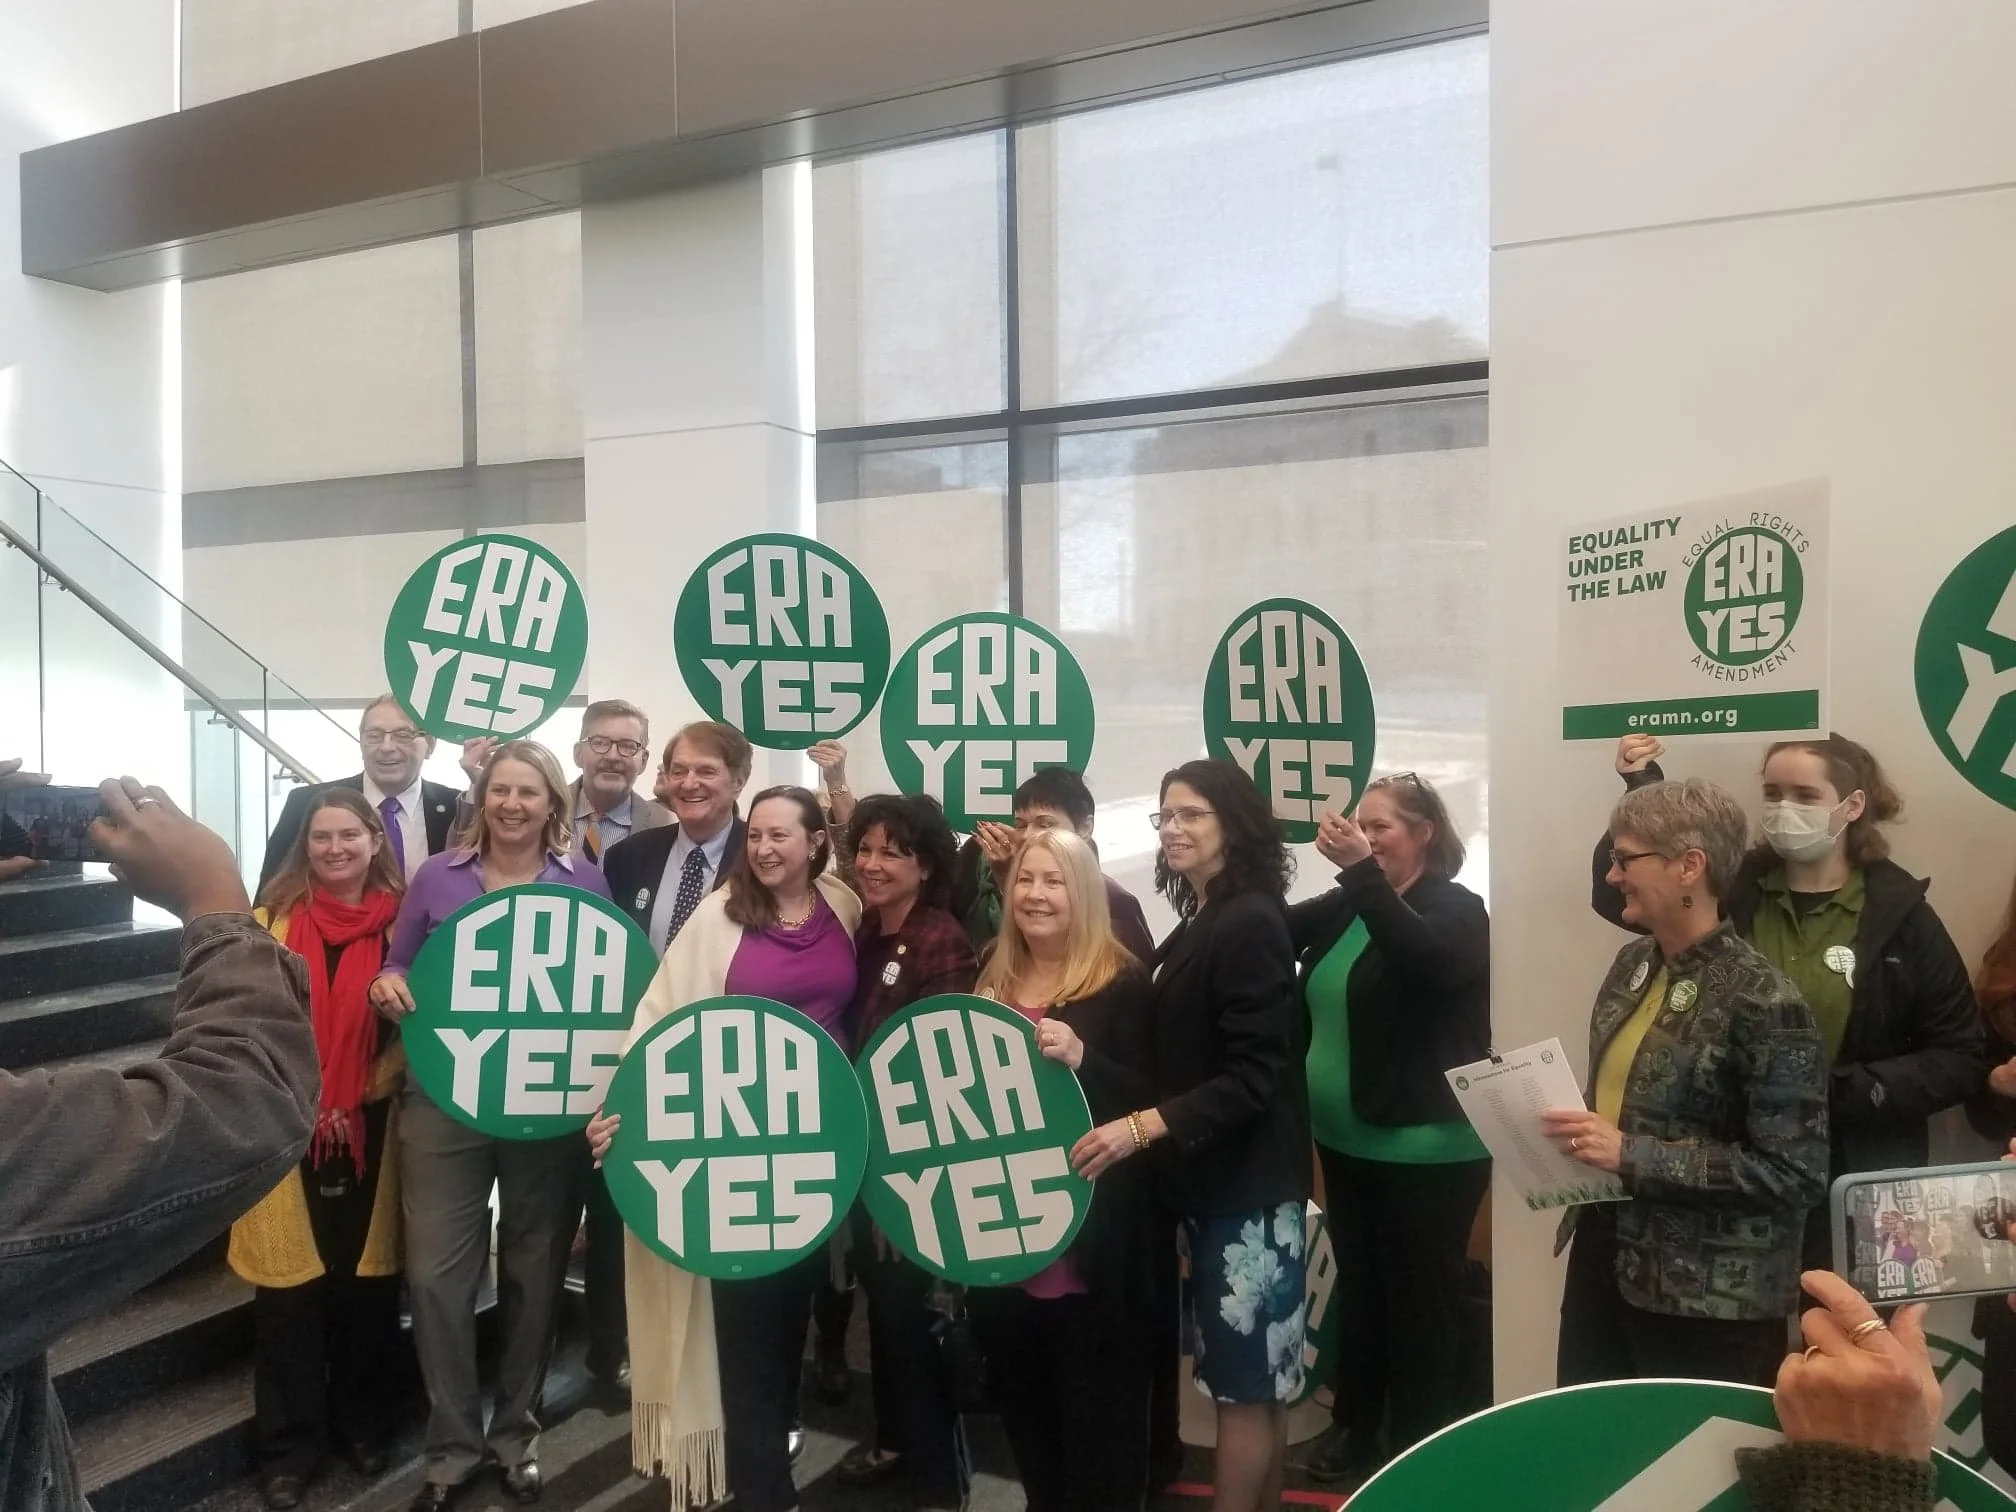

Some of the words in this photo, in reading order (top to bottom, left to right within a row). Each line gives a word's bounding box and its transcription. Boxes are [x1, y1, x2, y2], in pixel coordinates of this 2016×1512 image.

[1568, 549, 1644, 578] UNDER
[1569, 516, 1682, 555] EQUALITY
[1682, 518, 1734, 567] EQUAL
[1750, 512, 1809, 554] RIGHTS
[1704, 533, 1783, 602] ERA
[423, 542, 567, 652] ERA
[708, 545, 852, 647] ERA
[1567, 579, 1610, 602] THE
[1617, 570, 1667, 596] LAW
[1697, 601, 1786, 657] YES
[408, 641, 556, 733] YES
[701, 659, 865, 733] YES
[918, 623, 1057, 725] ERA
[1228, 611, 1343, 723] ERA
[1691, 640, 1796, 682] AMENDMENT
[1628, 707, 1738, 726] eramn.org
[451, 895, 627, 1013] ERA
[434, 1029, 631, 1119] YES
[646, 1009, 821, 1142] ERA
[870, 1010, 1046, 1153] ERA
[634, 1152, 836, 1259] YES
[882, 1147, 1074, 1269] YES
